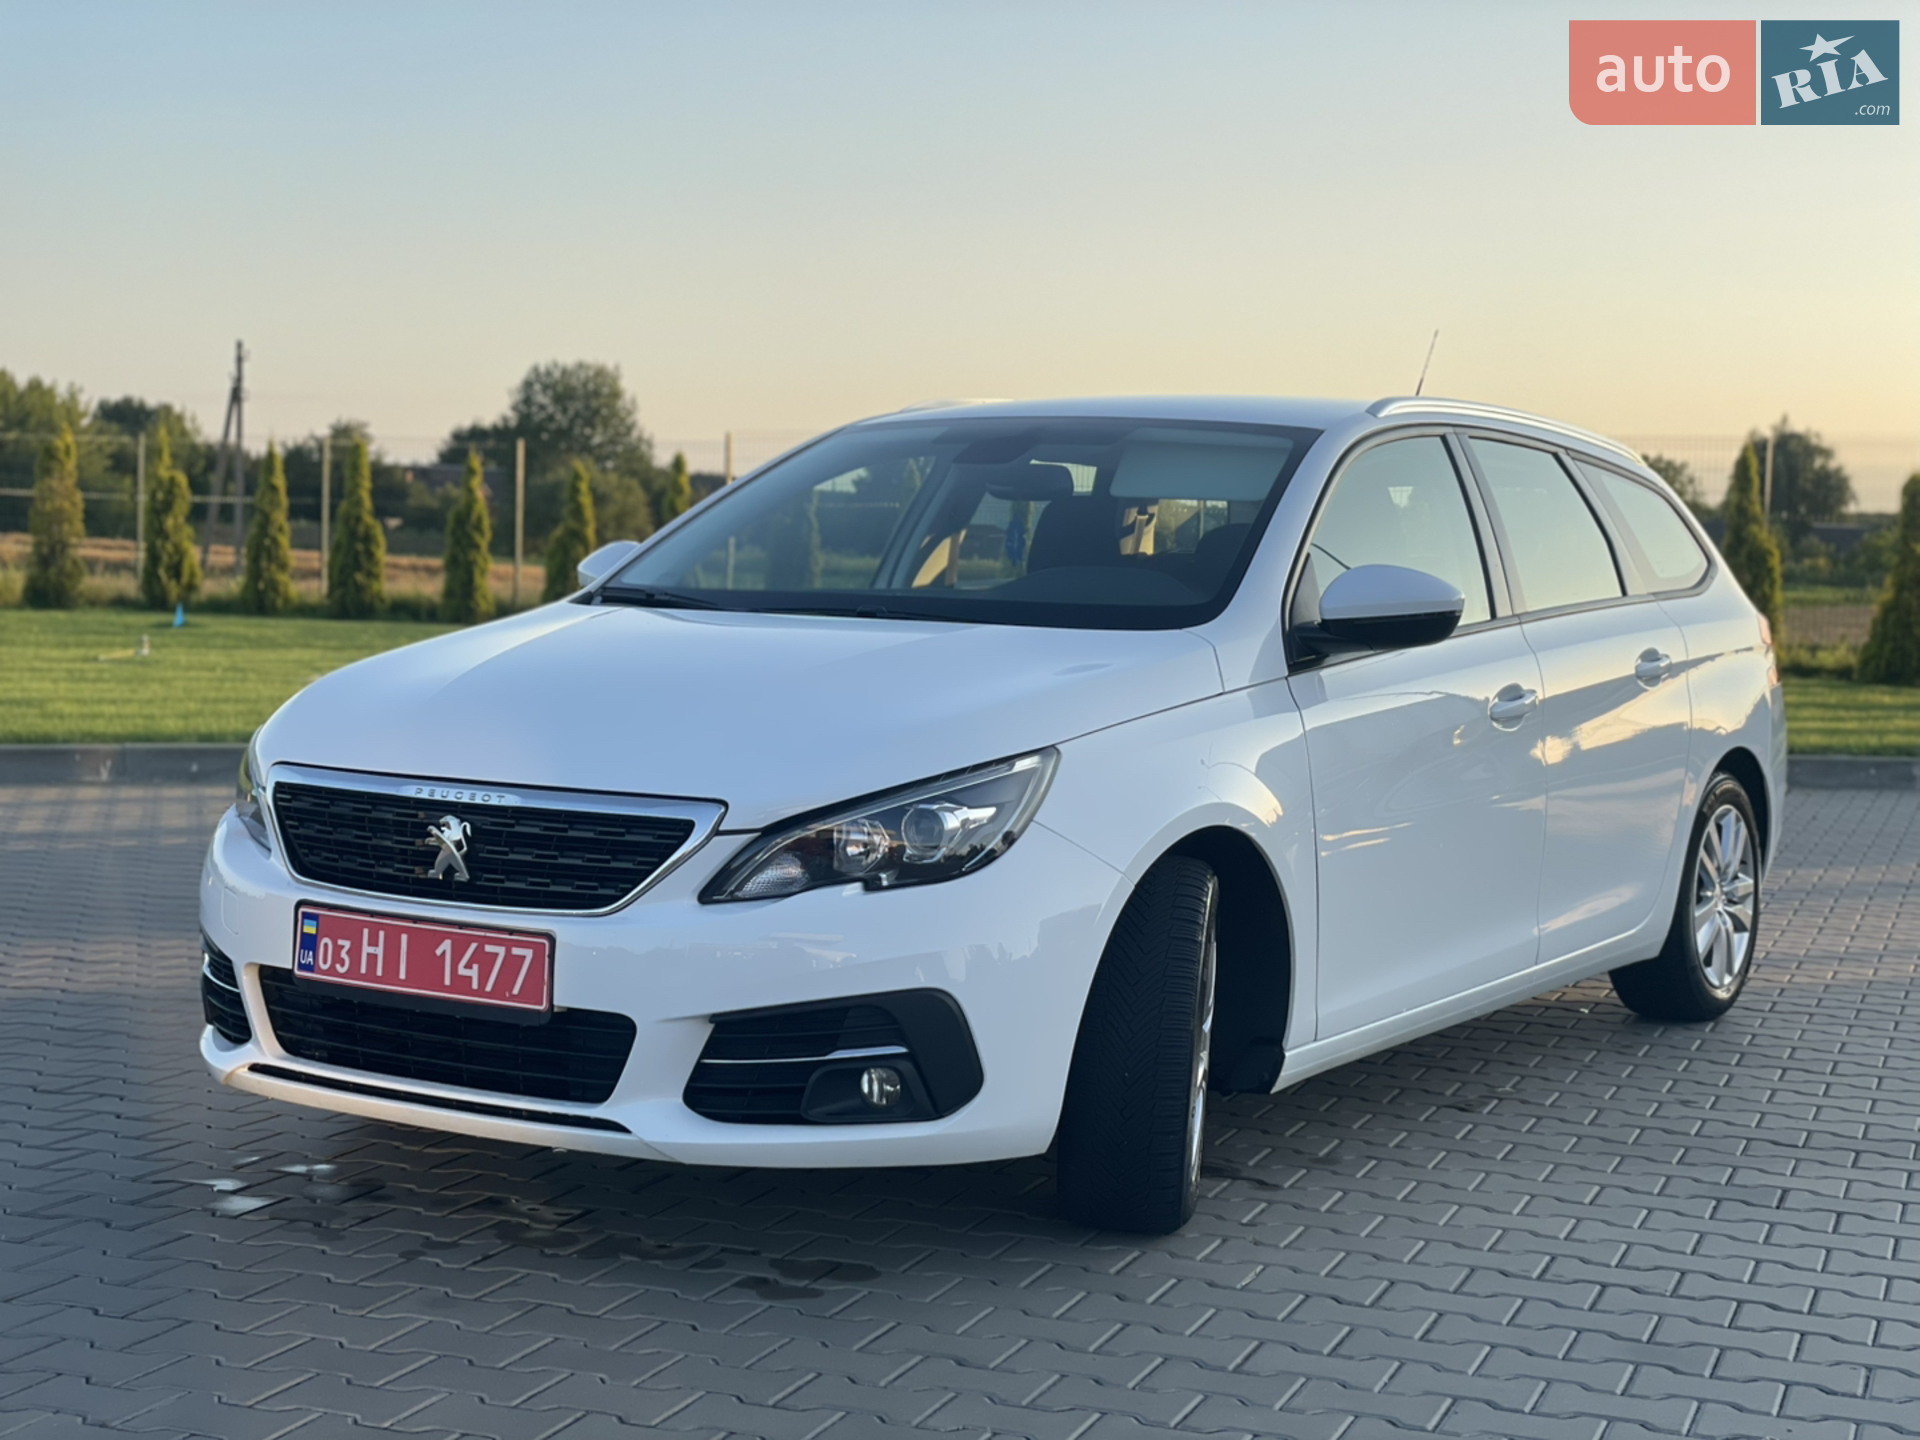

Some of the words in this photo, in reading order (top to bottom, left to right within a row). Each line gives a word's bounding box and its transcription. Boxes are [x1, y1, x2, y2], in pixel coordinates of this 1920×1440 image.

[415, 787, 506, 803] PEUGEOT
[300, 949, 314, 966] UA
[435, 938, 533, 995] 1477
